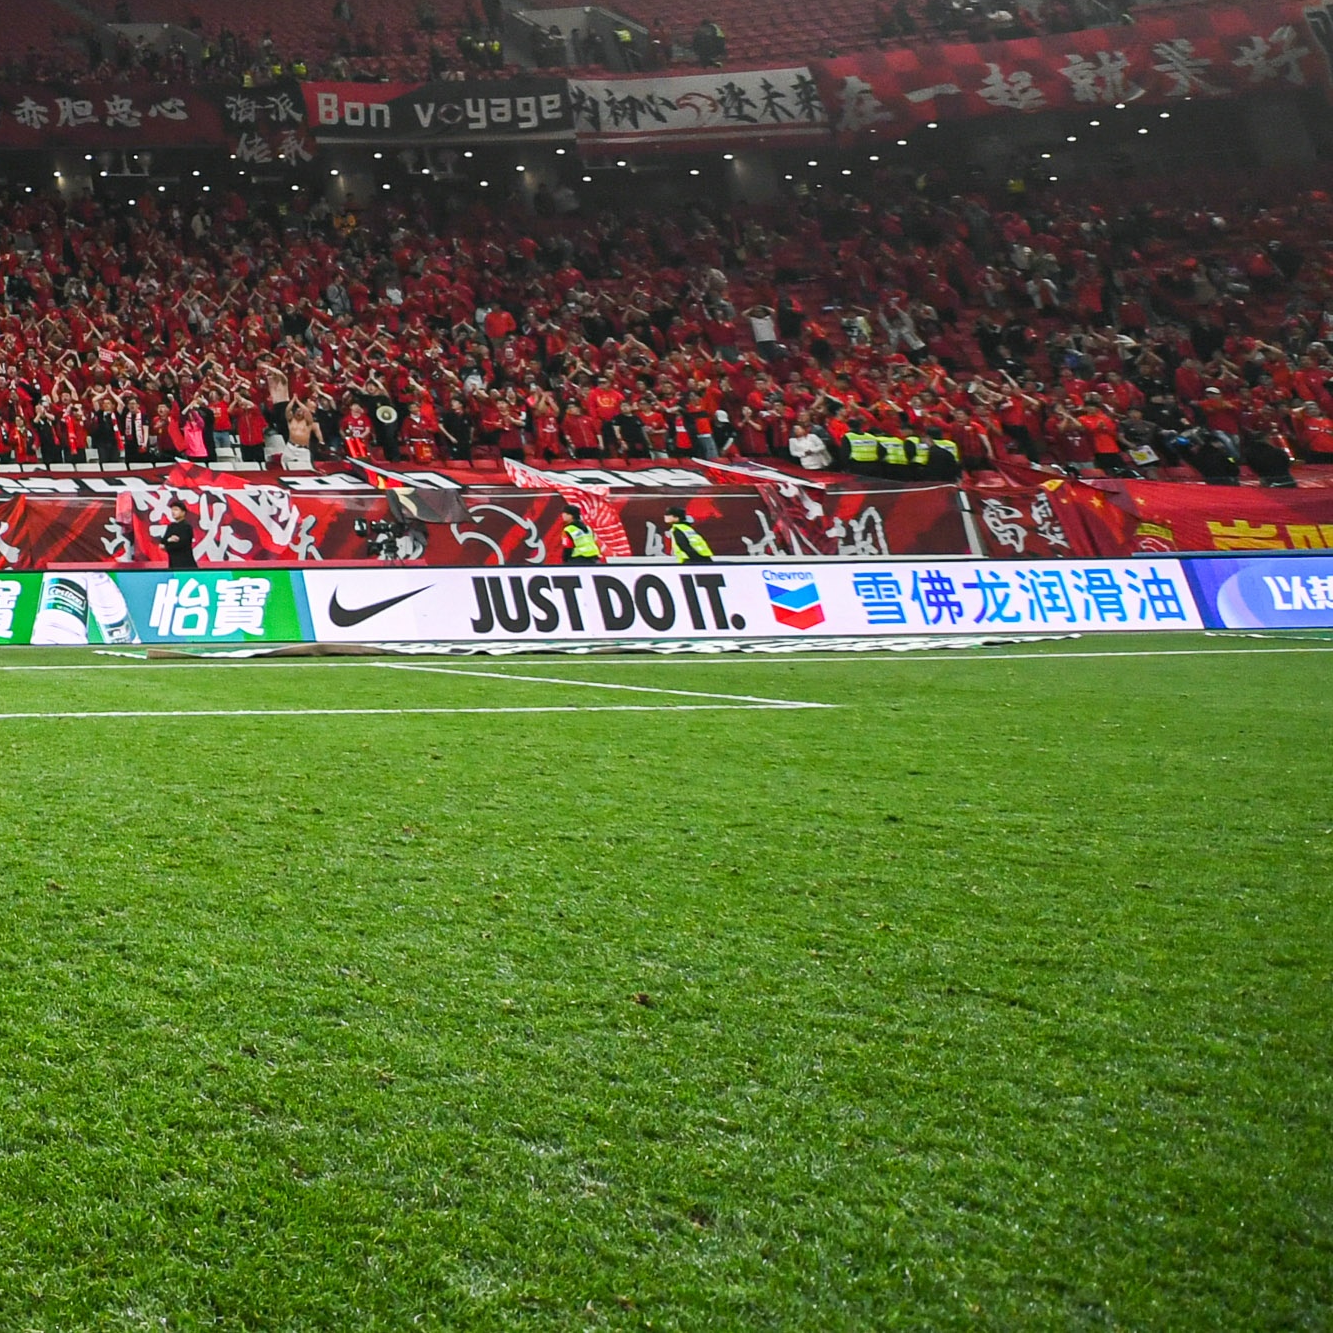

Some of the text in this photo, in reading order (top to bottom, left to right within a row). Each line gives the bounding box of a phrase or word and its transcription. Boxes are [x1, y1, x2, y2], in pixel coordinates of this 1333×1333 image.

[14, 94, 189, 128] 赤胆忠心
[226, 93, 303, 124] 海派
[317, 92, 563, 129] Bon voyage
[762, 569, 814, 581] Chevron
[149, 577, 271, 637] 怡寶
[470, 573, 746, 633] JUST DO IT.
[852, 567, 1187, 624] 雪佛龙润滑油
